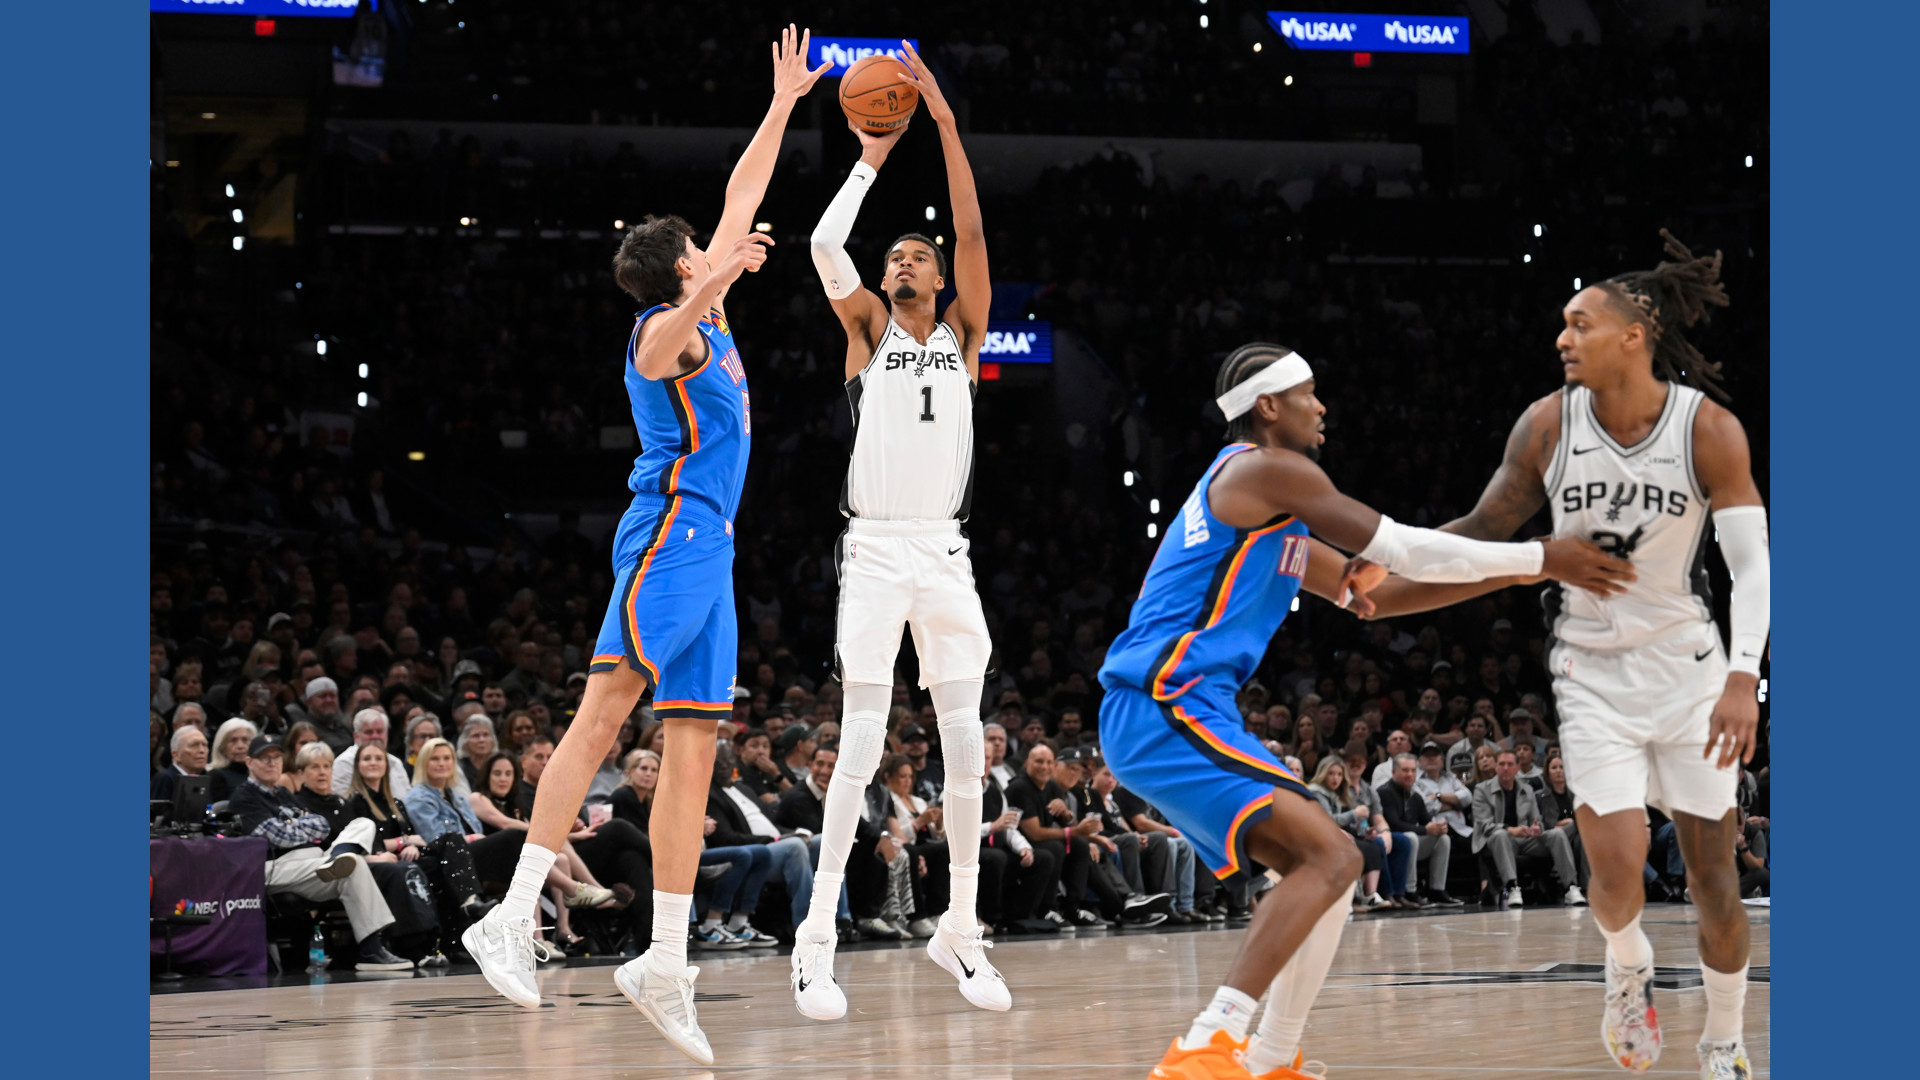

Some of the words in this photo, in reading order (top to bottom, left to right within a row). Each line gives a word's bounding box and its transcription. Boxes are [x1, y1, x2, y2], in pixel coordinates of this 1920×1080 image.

[1305, 22, 1352, 41] USAA
[1408, 25, 1455, 44] USAA
[886, 350, 957, 377] SPURS
[919, 385, 936, 423] 1
[1563, 481, 1688, 522] SPURS
[194, 901, 219, 915] NBC
